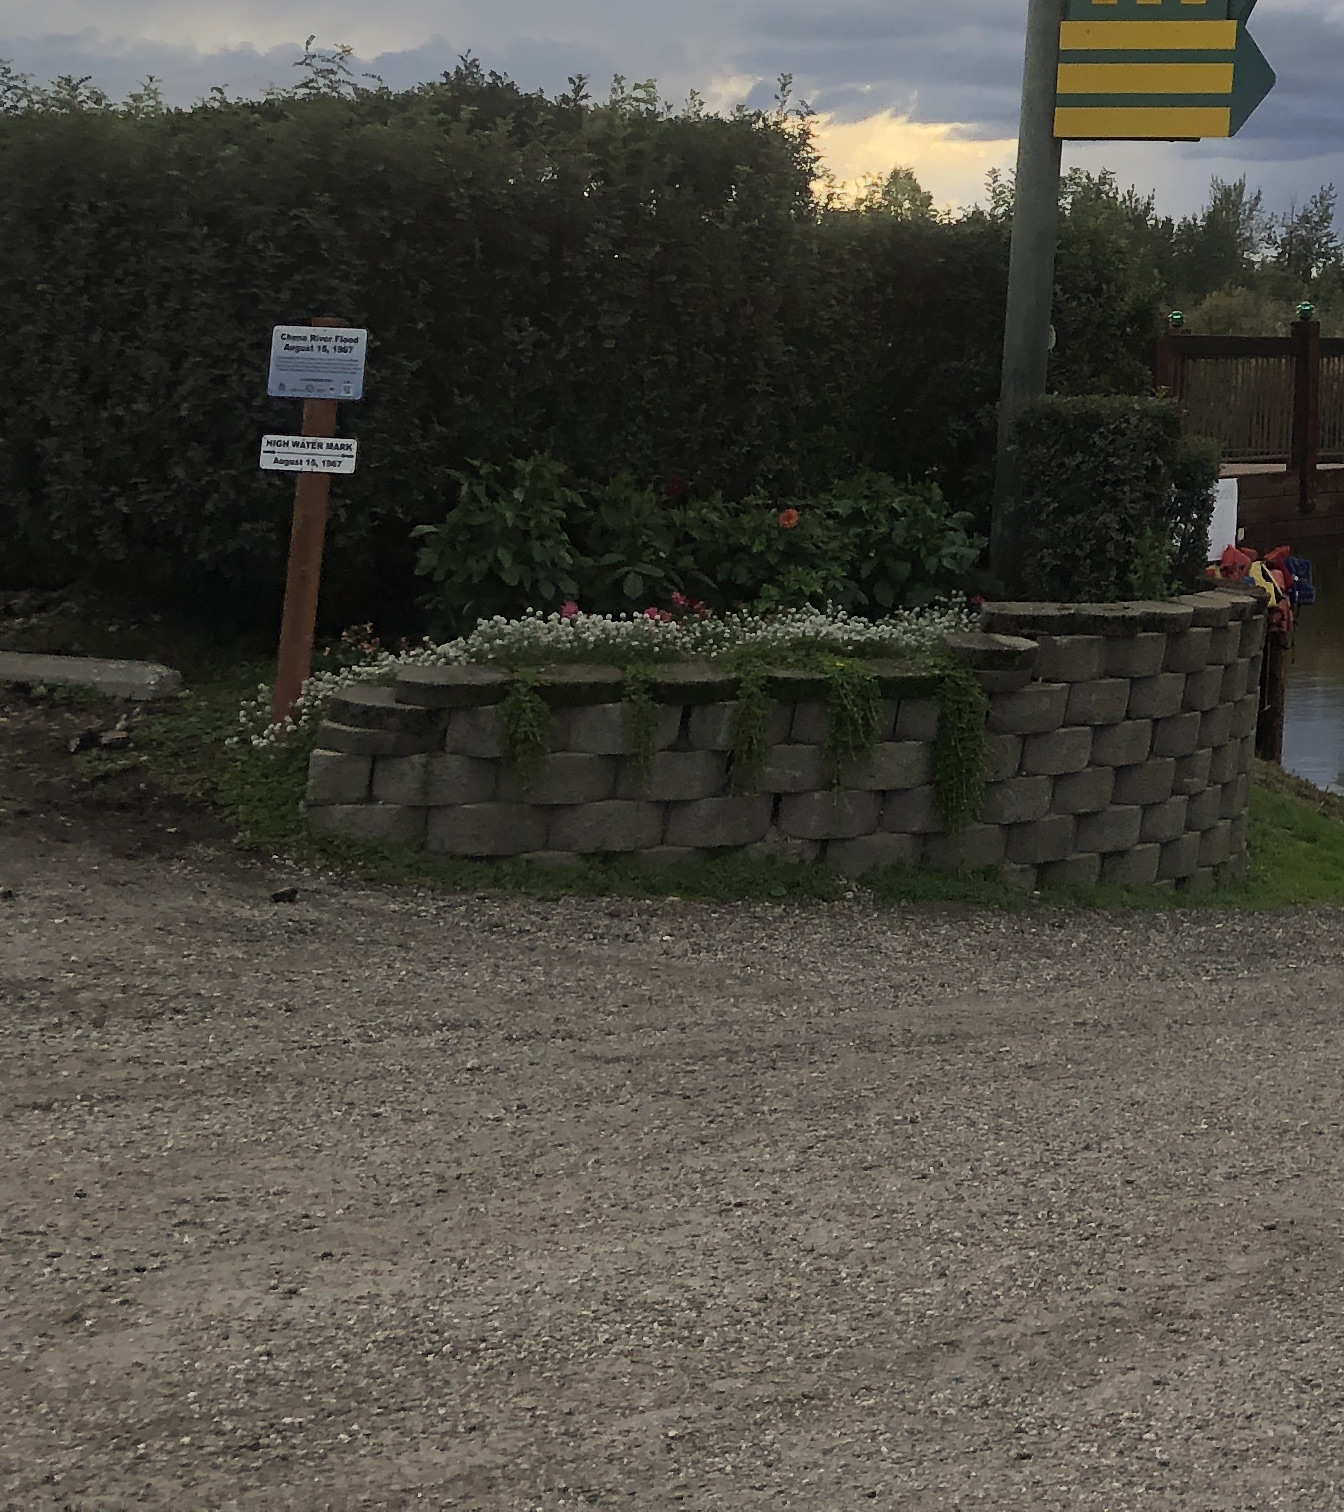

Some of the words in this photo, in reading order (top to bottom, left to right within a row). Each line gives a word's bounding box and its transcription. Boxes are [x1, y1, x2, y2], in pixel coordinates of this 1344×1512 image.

[310, 334, 332, 343] River
[335, 335, 359, 344] Flood
[284, 343, 314, 353] August
[333, 345, 354, 354] 1967
[266, 440, 289, 448] HIGH
[291, 440, 323, 450] WATER
[325, 442, 353, 451] MARK
[273, 457, 303, 466] August
[321, 459, 343, 468] 1967
